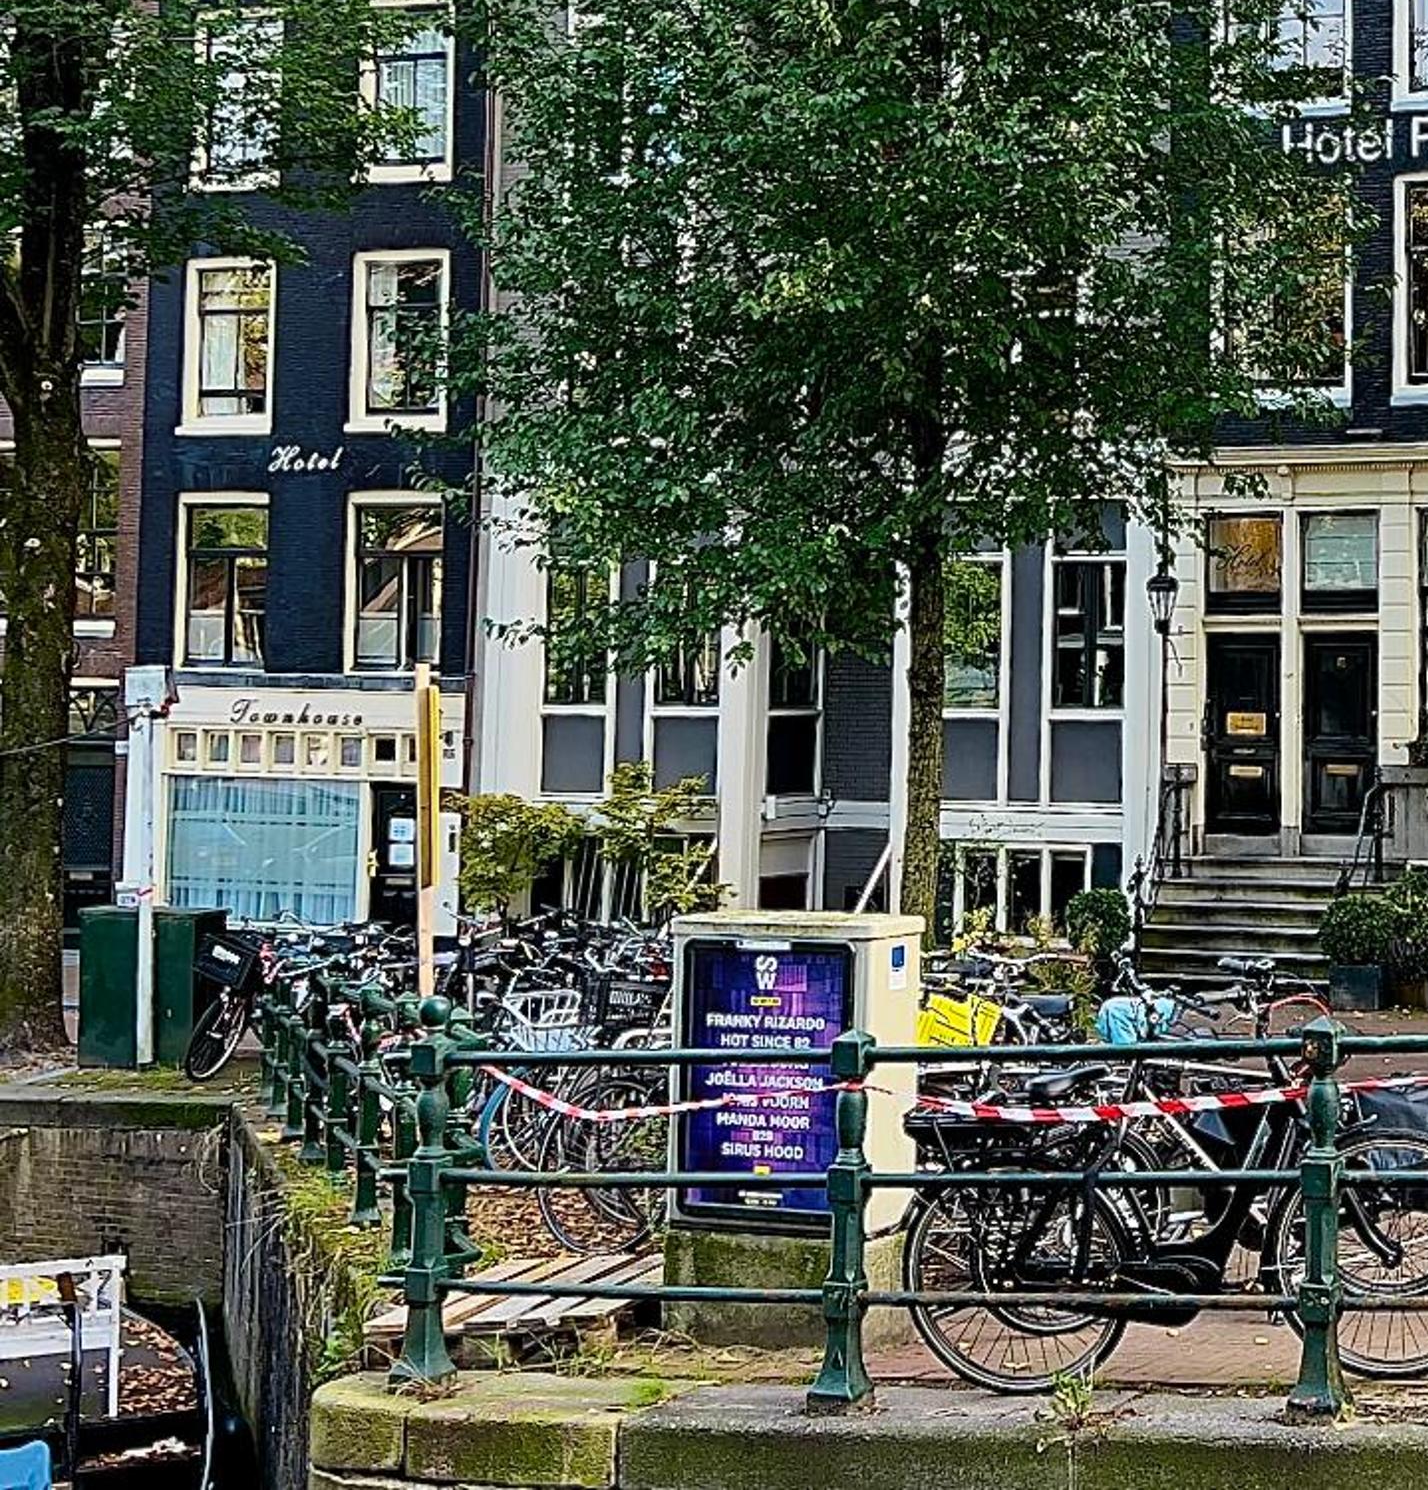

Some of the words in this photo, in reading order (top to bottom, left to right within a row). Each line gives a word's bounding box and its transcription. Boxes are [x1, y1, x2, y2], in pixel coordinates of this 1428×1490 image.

[1282, 119, 1393, 164] Hotel
[267, 444, 344, 472] Hotel
[230, 697, 363, 726] Townhouse
[706, 1013, 762, 1029] FRANKY
[764, 1016, 826, 1031] RIZARDO
[720, 1033, 749, 1047] HOT
[751, 1035, 791, 1049] SINCE
[705, 1070, 757, 1087] JOËLLA
[716, 1111, 767, 1127] MANDA
[769, 1115, 810, 1129] MOOR
[721, 1142, 762, 1157] SIRUS
[764, 1145, 804, 1160] HOOD
